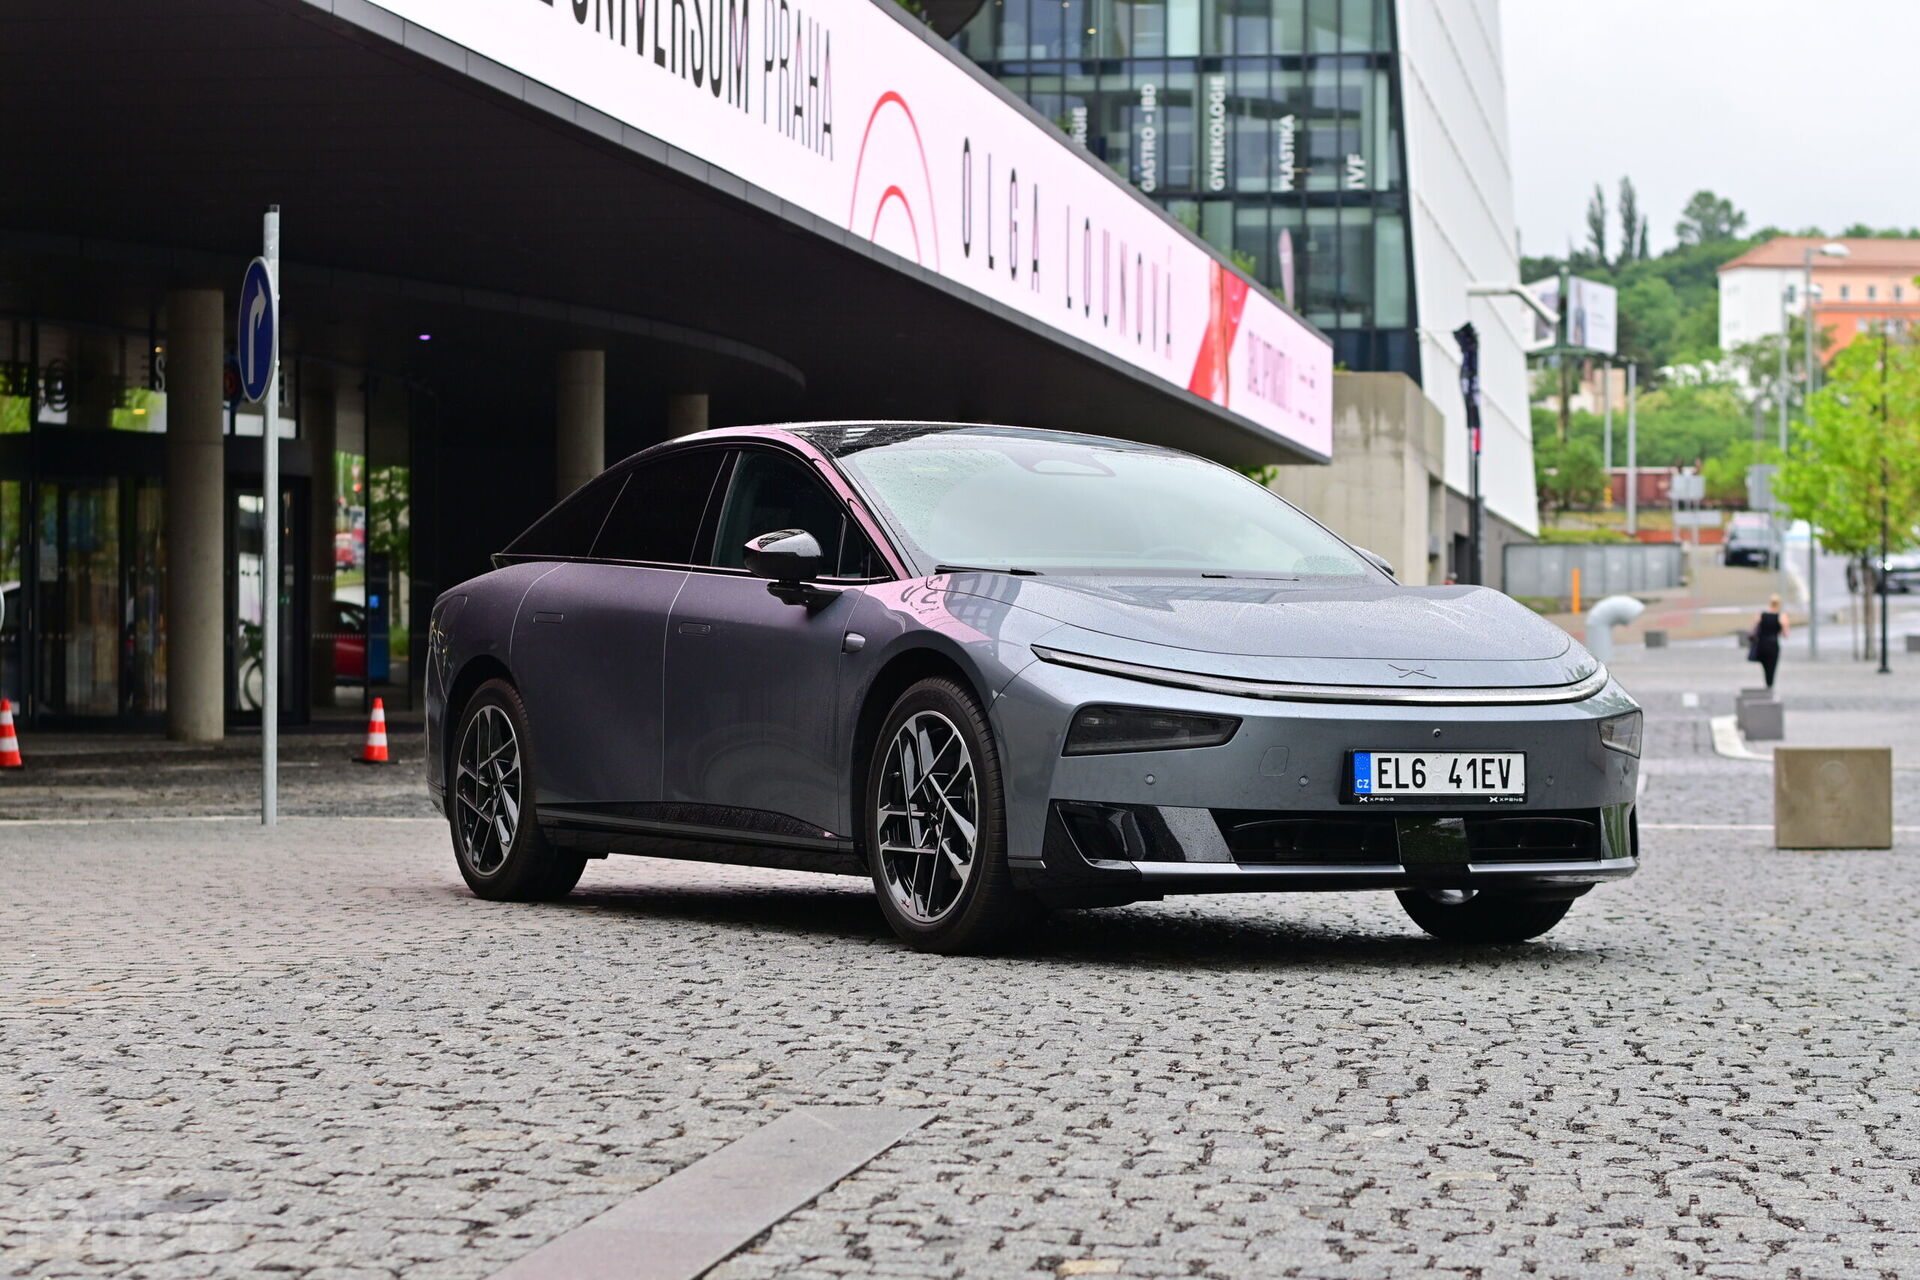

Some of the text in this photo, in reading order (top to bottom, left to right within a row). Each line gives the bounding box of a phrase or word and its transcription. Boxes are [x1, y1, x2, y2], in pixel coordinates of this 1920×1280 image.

[763, 0, 833, 161] PRAHA
[1141, 83, 1156, 111] IBD
[1072, 106, 1088, 149] RGIE
[1209, 76, 1226, 191] GYNEKOLOGIE
[1278, 114, 1295, 191] PLASTIKA
[1141, 126, 1156, 192] GASTRO
[1346, 153, 1367, 190] IVF
[961, 136, 1040, 294] OLGA
[1356, 779, 1369, 789] CZ
[1377, 757, 1512, 789] EL6 41EV
